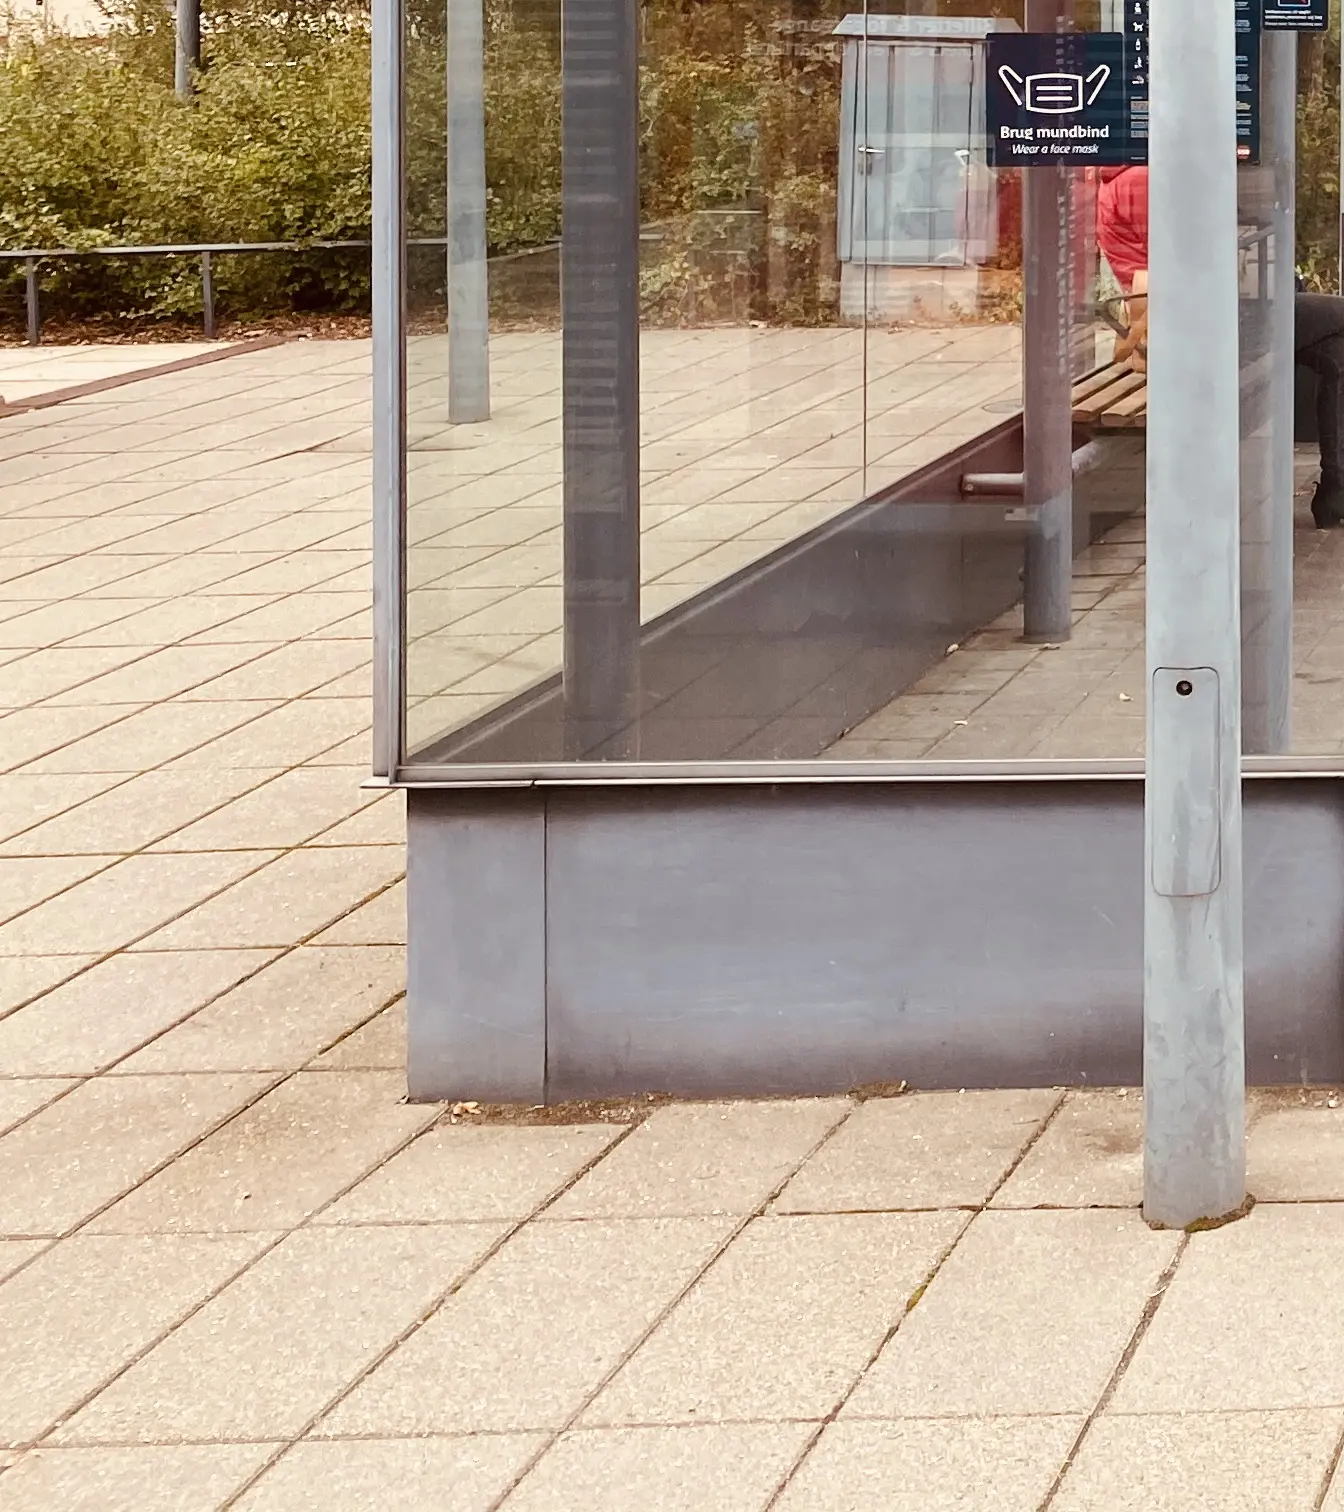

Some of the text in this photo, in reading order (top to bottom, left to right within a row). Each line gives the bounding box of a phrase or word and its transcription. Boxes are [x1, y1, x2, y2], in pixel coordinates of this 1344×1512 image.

[1000, 124, 1110, 141] Brug mundbind
[1011, 143, 1100, 155] Wear a face mask
